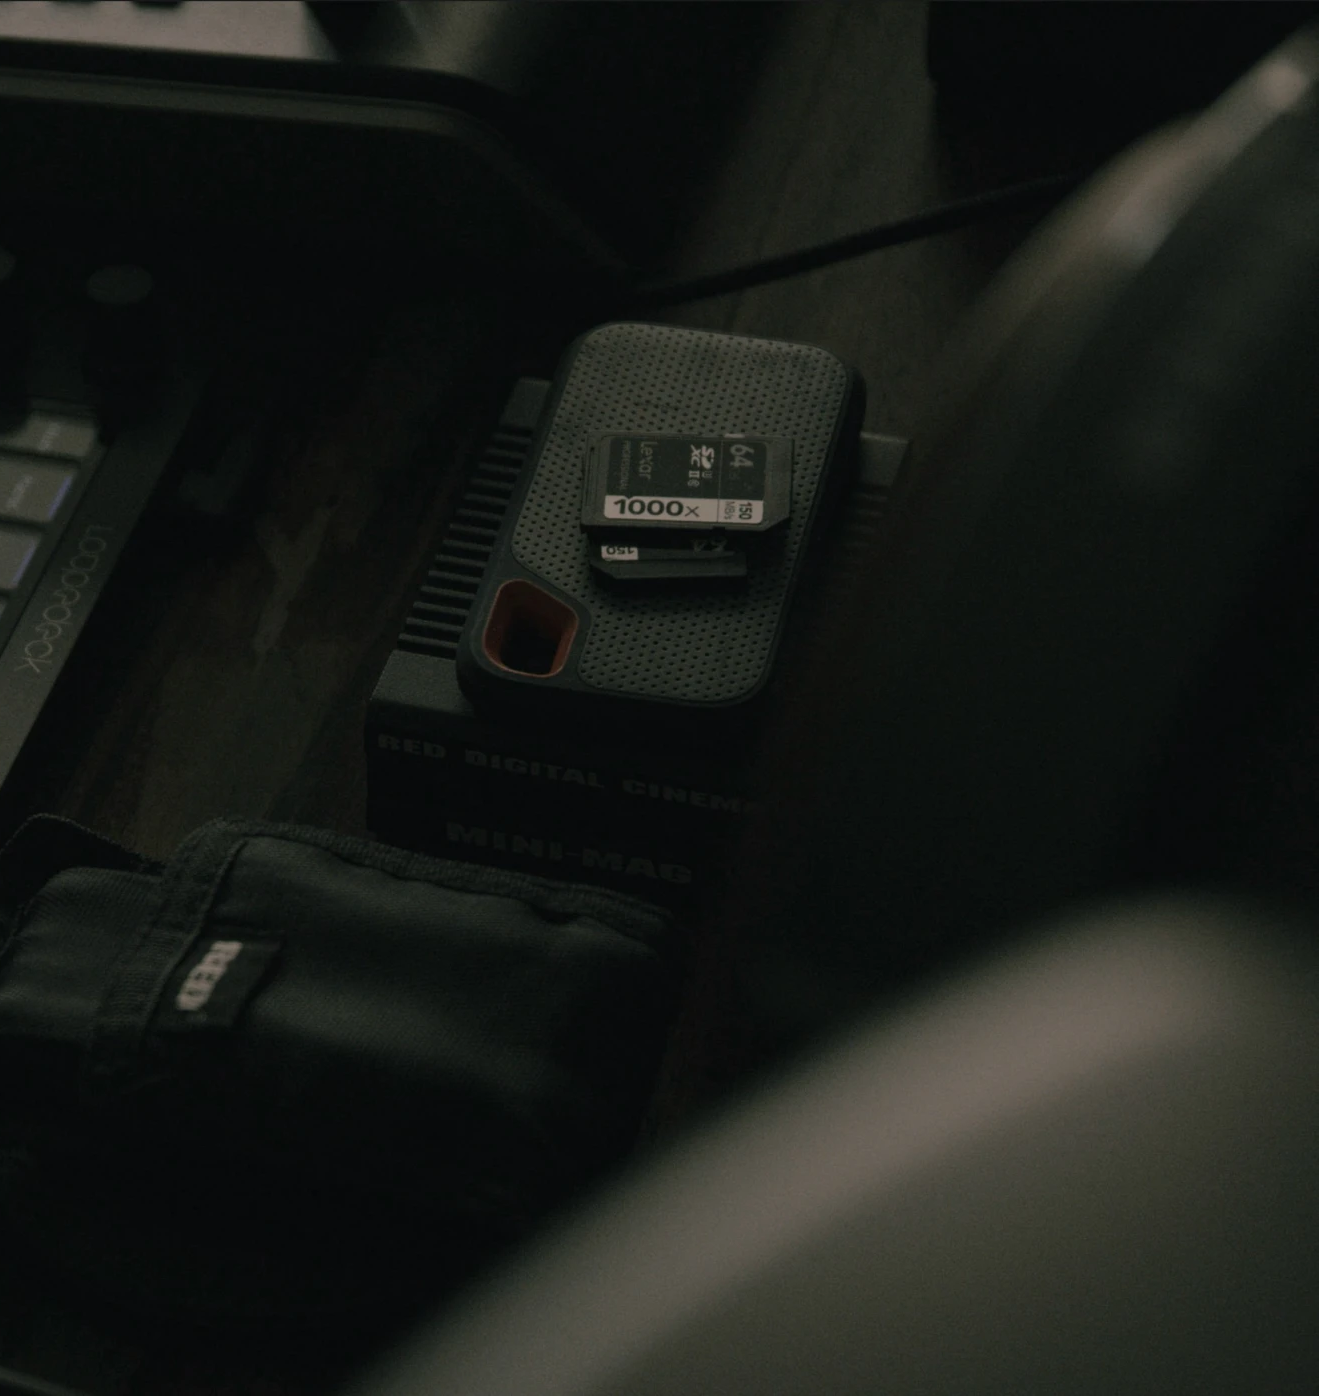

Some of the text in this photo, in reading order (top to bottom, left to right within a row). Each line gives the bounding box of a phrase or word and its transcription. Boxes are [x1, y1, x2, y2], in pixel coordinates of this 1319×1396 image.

[638, 441, 659, 480] Lexar
[730, 443, 754, 468] 64
[738, 502, 752, 520] 150
[378, 733, 446, 760] RED
[465, 749, 606, 789] DIGITAL
[445, 821, 693, 885] MINI-MAG
